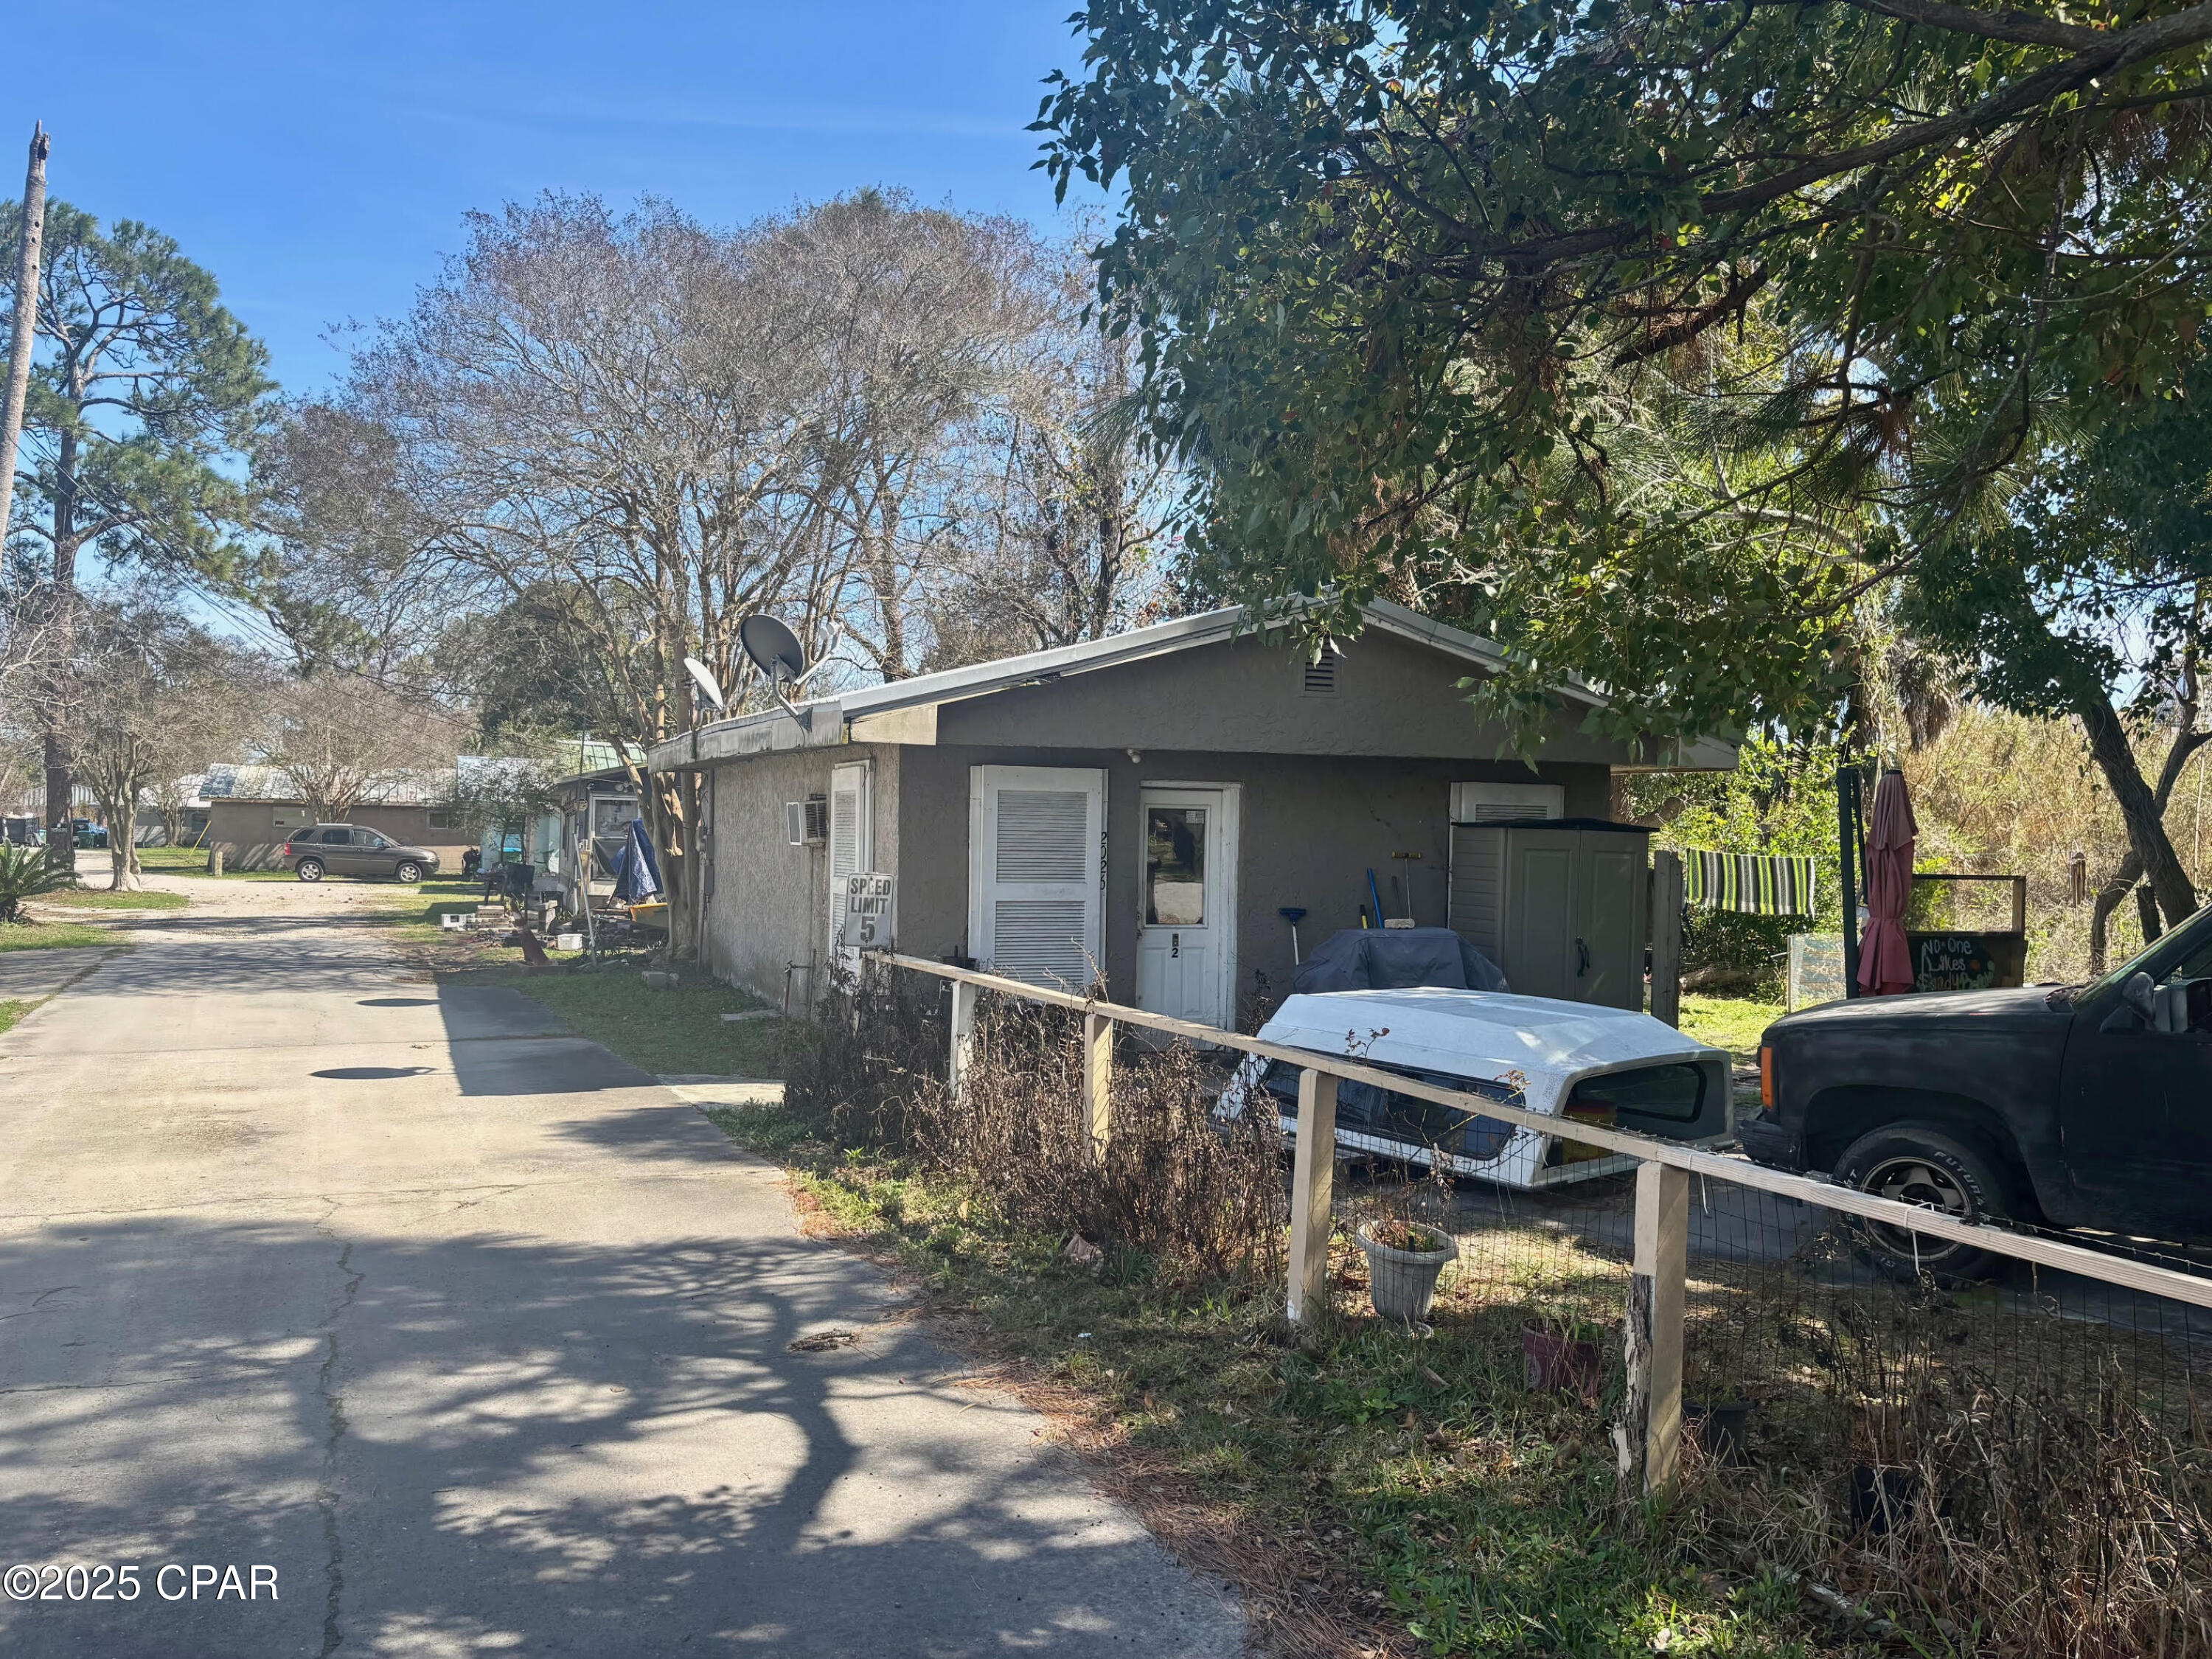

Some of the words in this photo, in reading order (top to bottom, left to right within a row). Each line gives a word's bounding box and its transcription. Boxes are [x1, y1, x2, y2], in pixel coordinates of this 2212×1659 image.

[850, 877, 891, 896] SPEED
[850, 897, 888, 914] LIMIT
[860, 916, 875, 944] 5
[1172, 947, 1178, 958] 2
